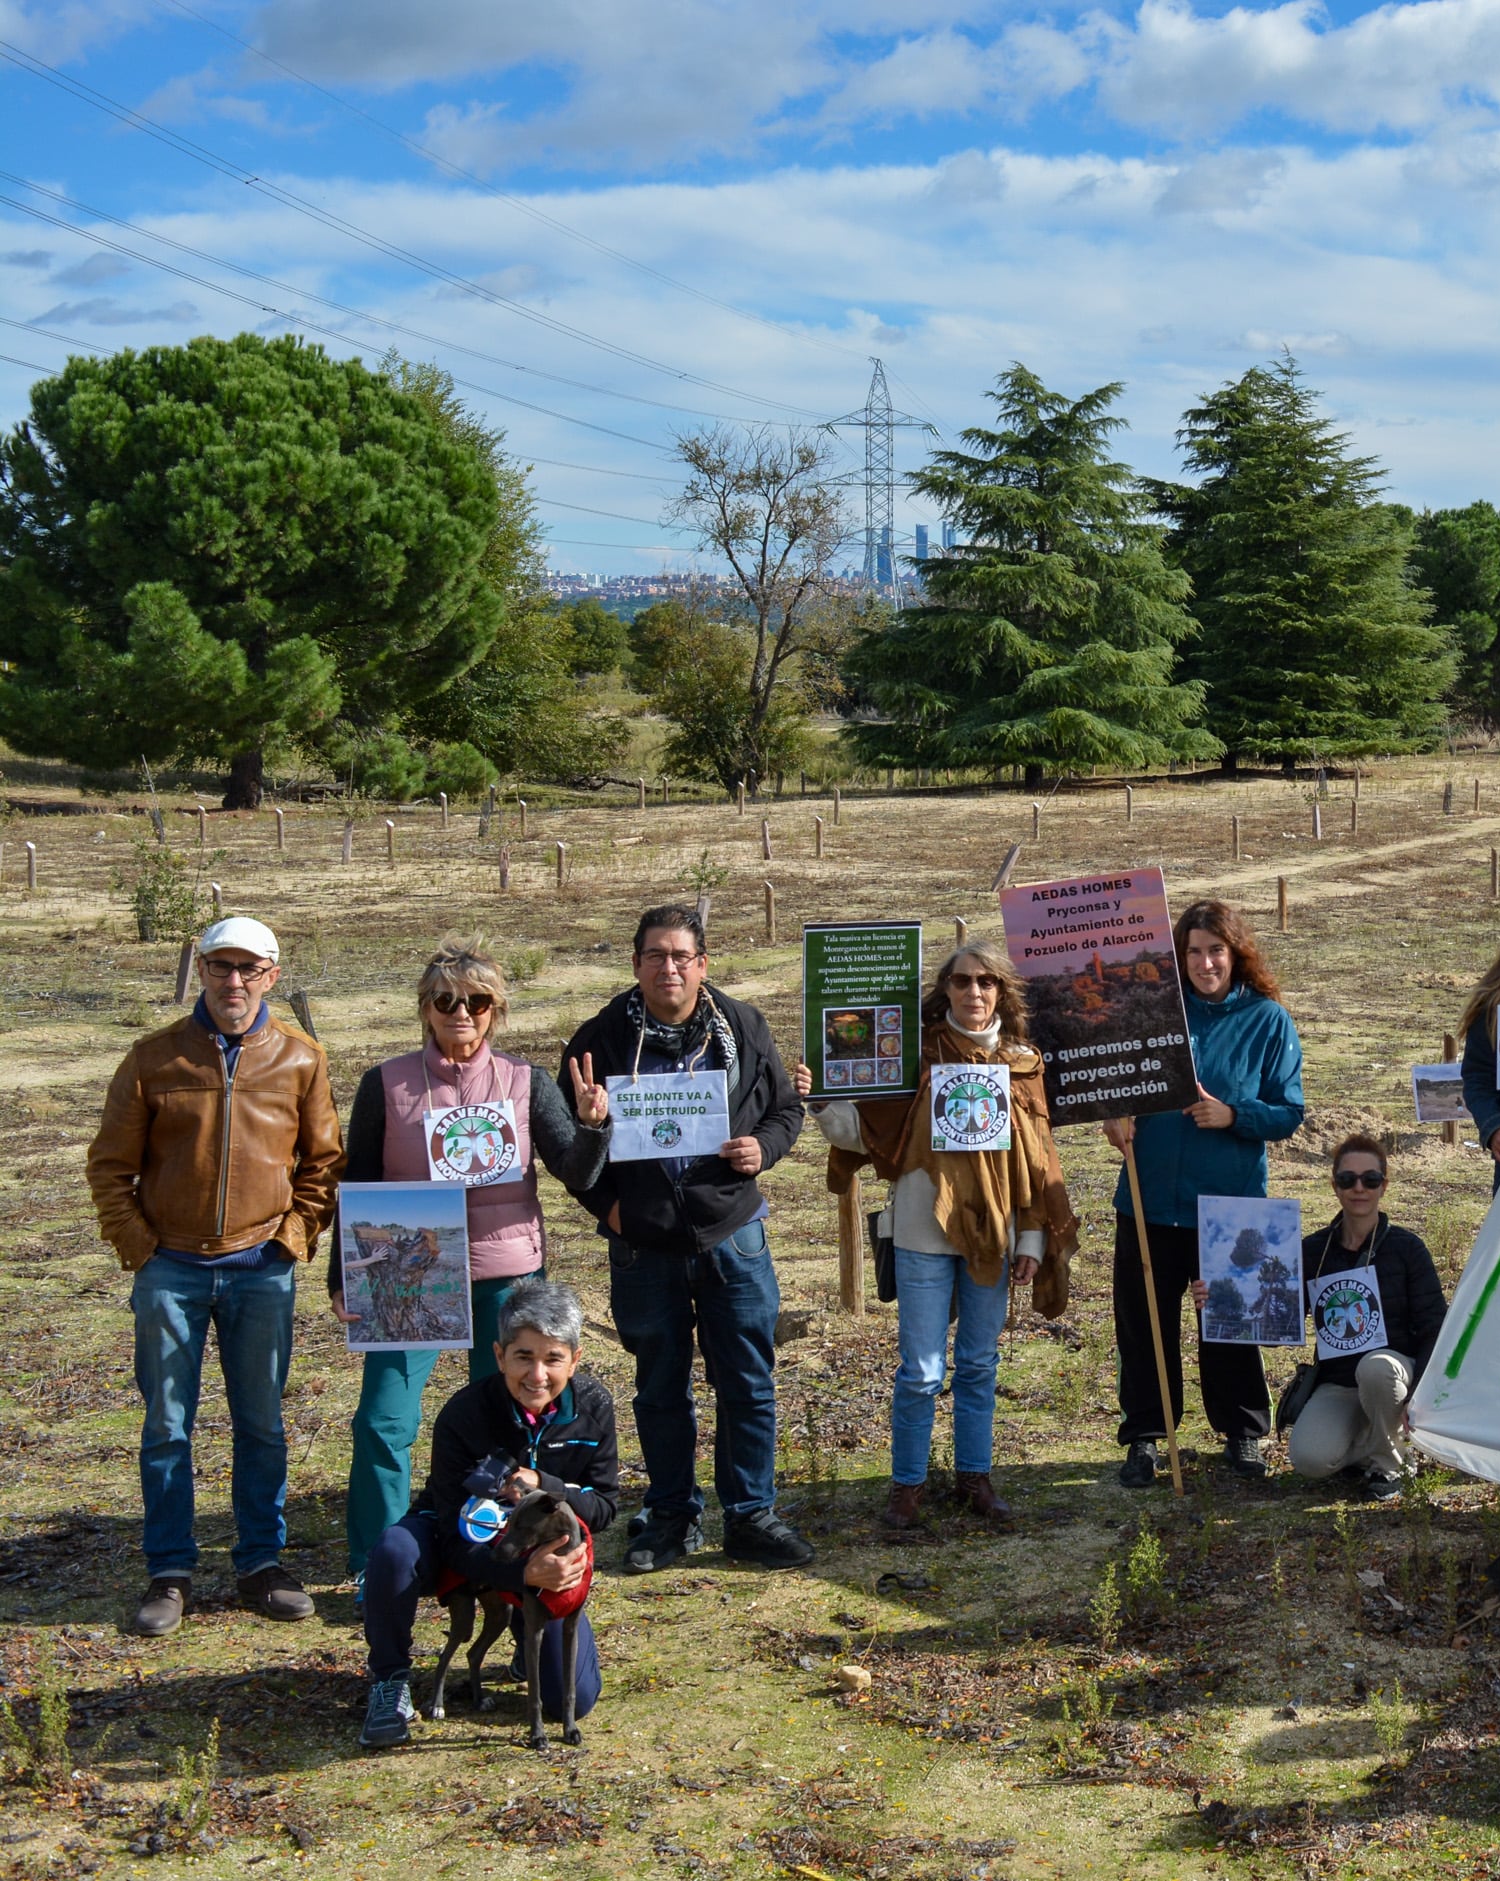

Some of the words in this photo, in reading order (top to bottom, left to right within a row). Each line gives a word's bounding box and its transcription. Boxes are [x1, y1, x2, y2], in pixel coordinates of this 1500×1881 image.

[1032, 885, 1078, 902] AEDAS
[1082, 878, 1132, 895] HOMES
[1047, 900, 1110, 918] Pryconsa
[1113, 899, 1121, 911] y
[824, 934, 838, 942] Tala
[872, 933, 897, 941] licencia
[1031, 917, 1124, 939] Ayuntamiento
[1128, 913, 1145, 925] de
[823, 943, 871, 954] Montegancedo
[1024, 940, 1077, 957] Pozuelo
[1081, 937, 1098, 949] de
[1102, 931, 1154, 947] Alarcón
[827, 955, 853, 963] AEDAS
[854, 954, 882, 962] HOMES
[896, 953, 903, 961] el
[847, 964, 900, 973] desconocimiento
[901, 962, 911, 970] del
[824, 976, 870, 985] Ayuntamiento
[1043, 1052, 1053, 1063] o
[1058, 1039, 1143, 1064] queremos
[1147, 1033, 1184, 1048] este
[1060, 1062, 1136, 1086] proyecto
[1141, 1058, 1162, 1072] de
[617, 1093, 641, 1102] ESTE
[644, 1092, 684, 1101] MONTE
[686, 1091, 702, 1100] VA
[704, 1091, 713, 1100] A
[940, 1074, 1002, 1097] SALVEMOS
[1055, 1081, 1168, 1106] construcción
[436, 1107, 507, 1136] SALVEMOS
[622, 1108, 642, 1117] SER
[645, 1106, 707, 1117] DESTRUIDO
[936, 1110, 1007, 1144] MONTEGANCEDO
[1318, 1280, 1372, 1307] SALVEMOS
[1319, 1310, 1379, 1349] MONTEGANCEDO
